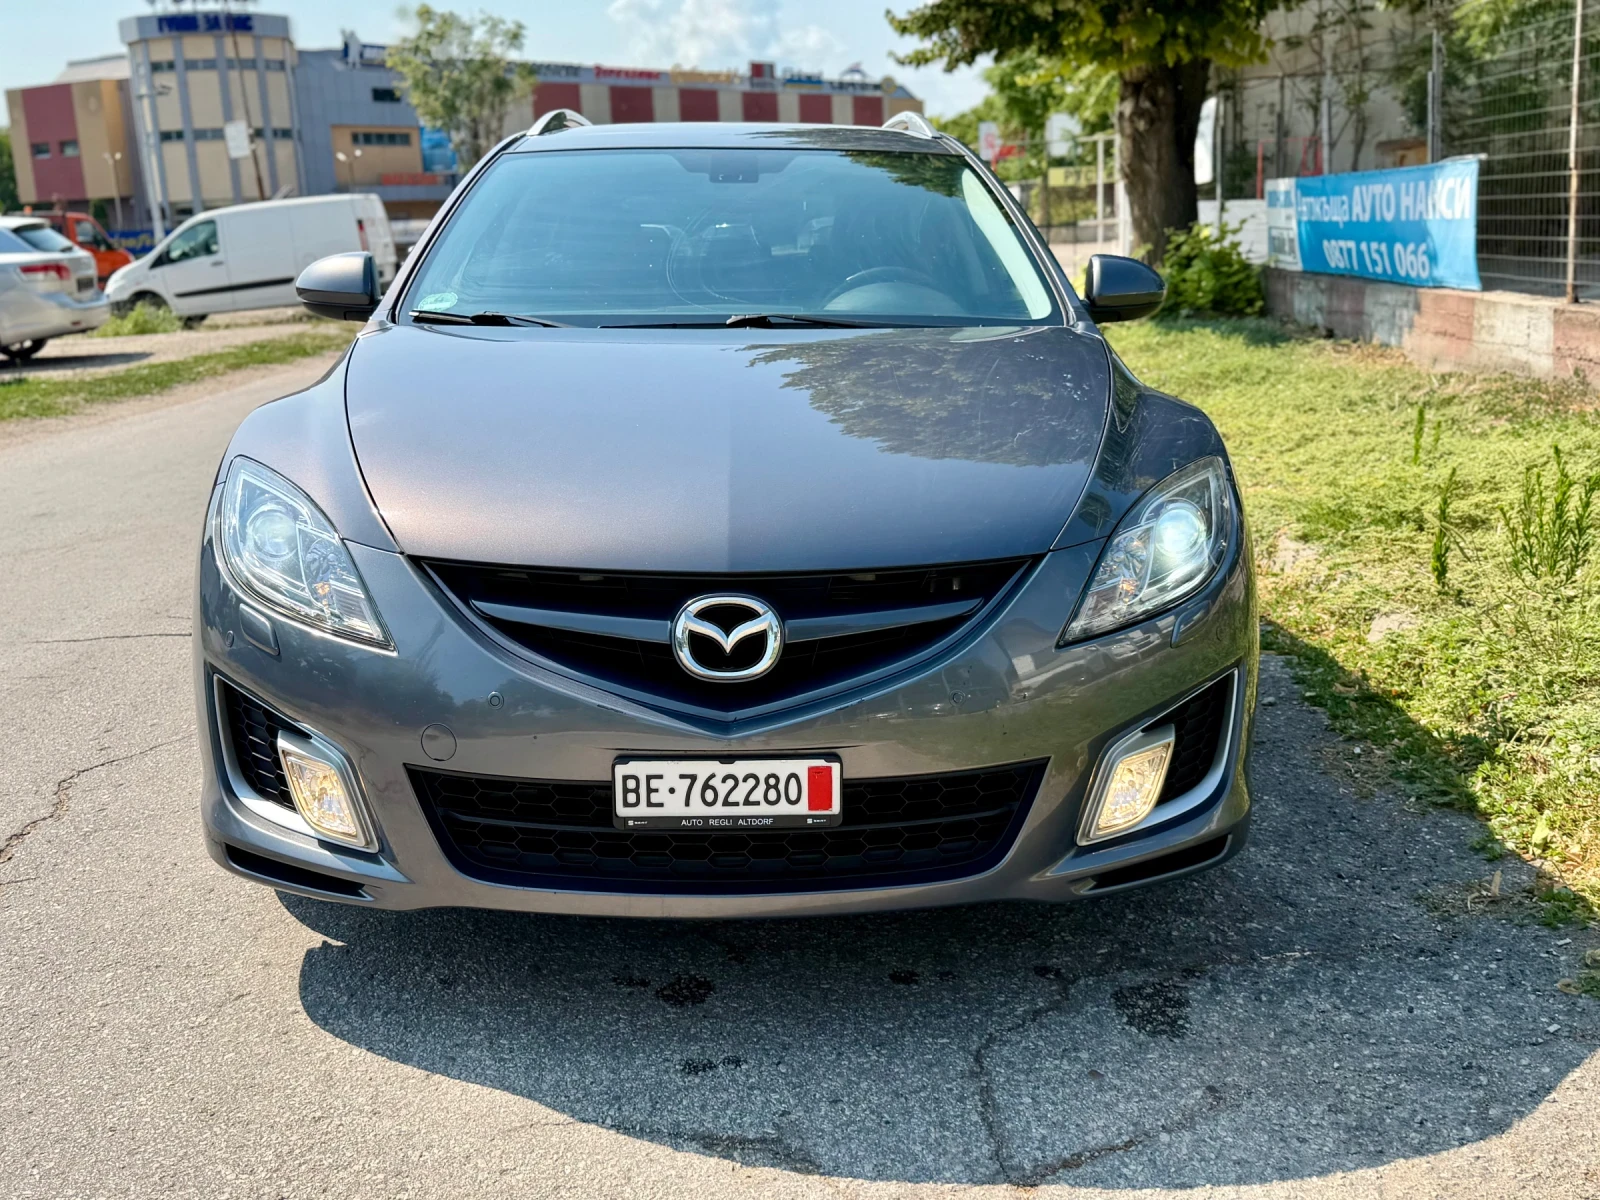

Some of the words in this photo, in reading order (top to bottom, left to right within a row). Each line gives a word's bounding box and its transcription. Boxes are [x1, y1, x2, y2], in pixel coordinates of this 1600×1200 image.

[1352, 183, 1396, 223] АУТО
[1322, 239, 1359, 271] 0877
[1360, 241, 1393, 275] 151
[1393, 241, 1431, 279] 066
[681, 818, 703, 827] AUTO
[708, 818, 733, 827] REGLI
[738, 818, 774, 827] ALTDORF
